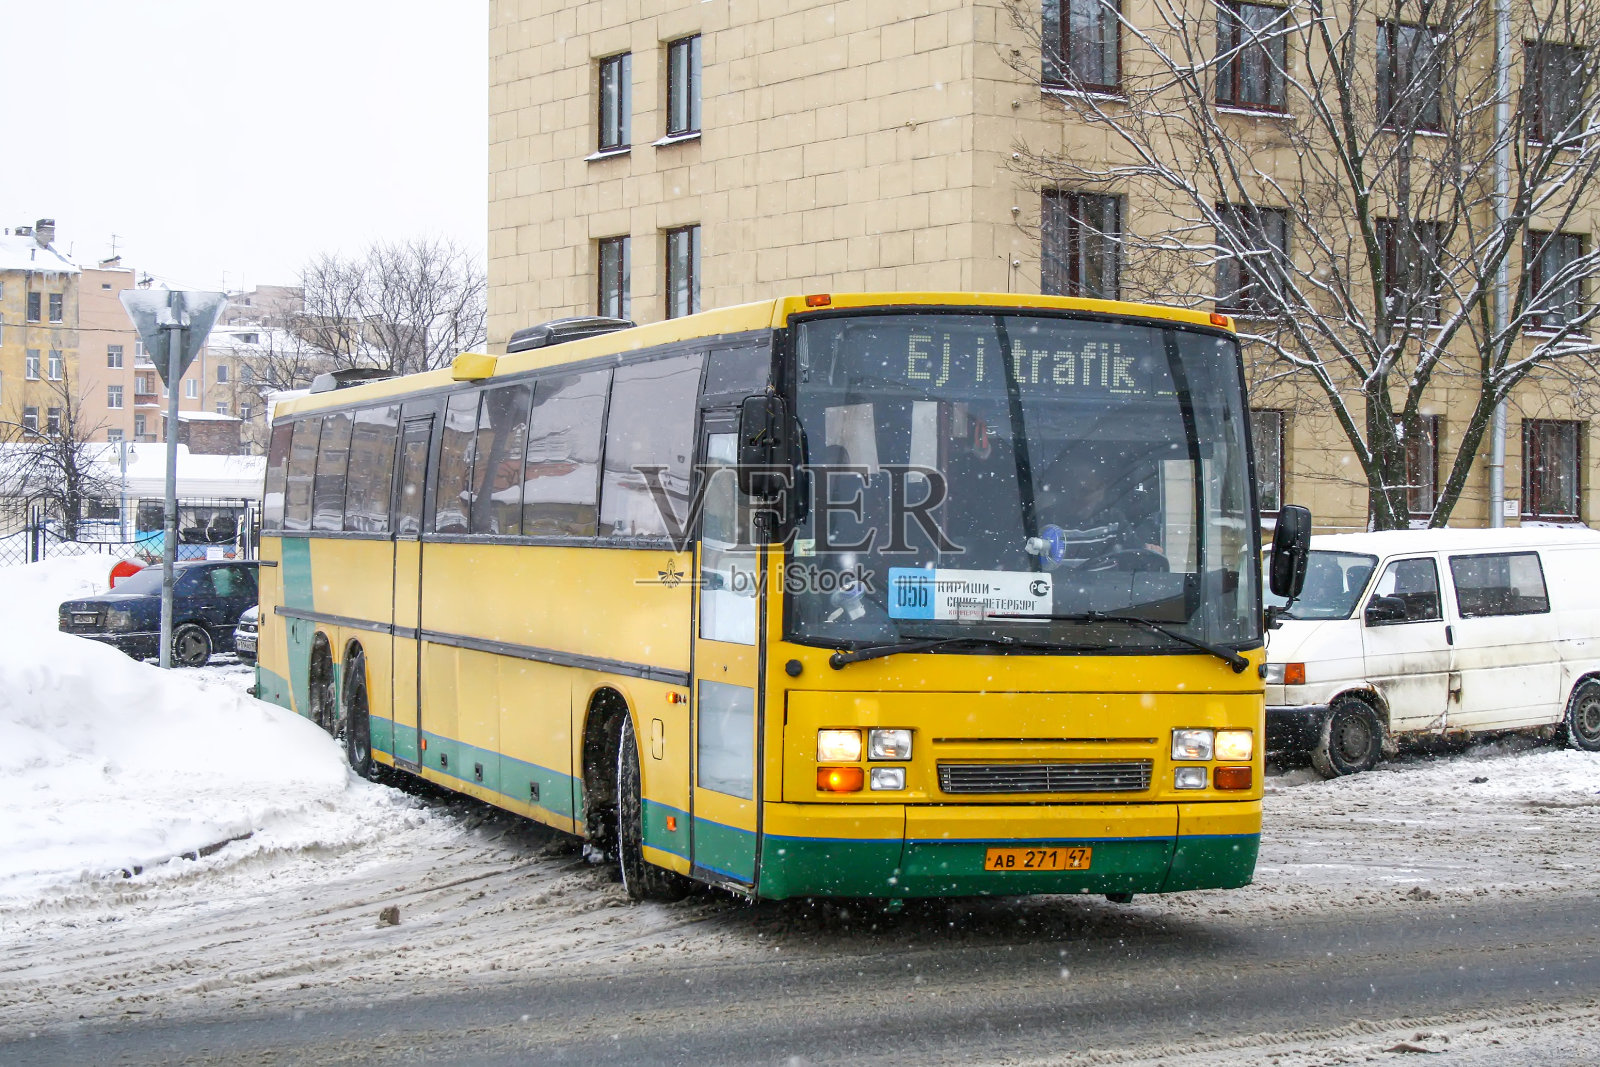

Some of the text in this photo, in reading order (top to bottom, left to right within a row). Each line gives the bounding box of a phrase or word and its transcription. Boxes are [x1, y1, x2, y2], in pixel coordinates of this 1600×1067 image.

[907, 333, 1135, 387] Ej i trafik
[937, 581, 990, 595] КИРИШИ
[1024, 850, 1058, 868] 271
[1068, 850, 1086, 863] 47
